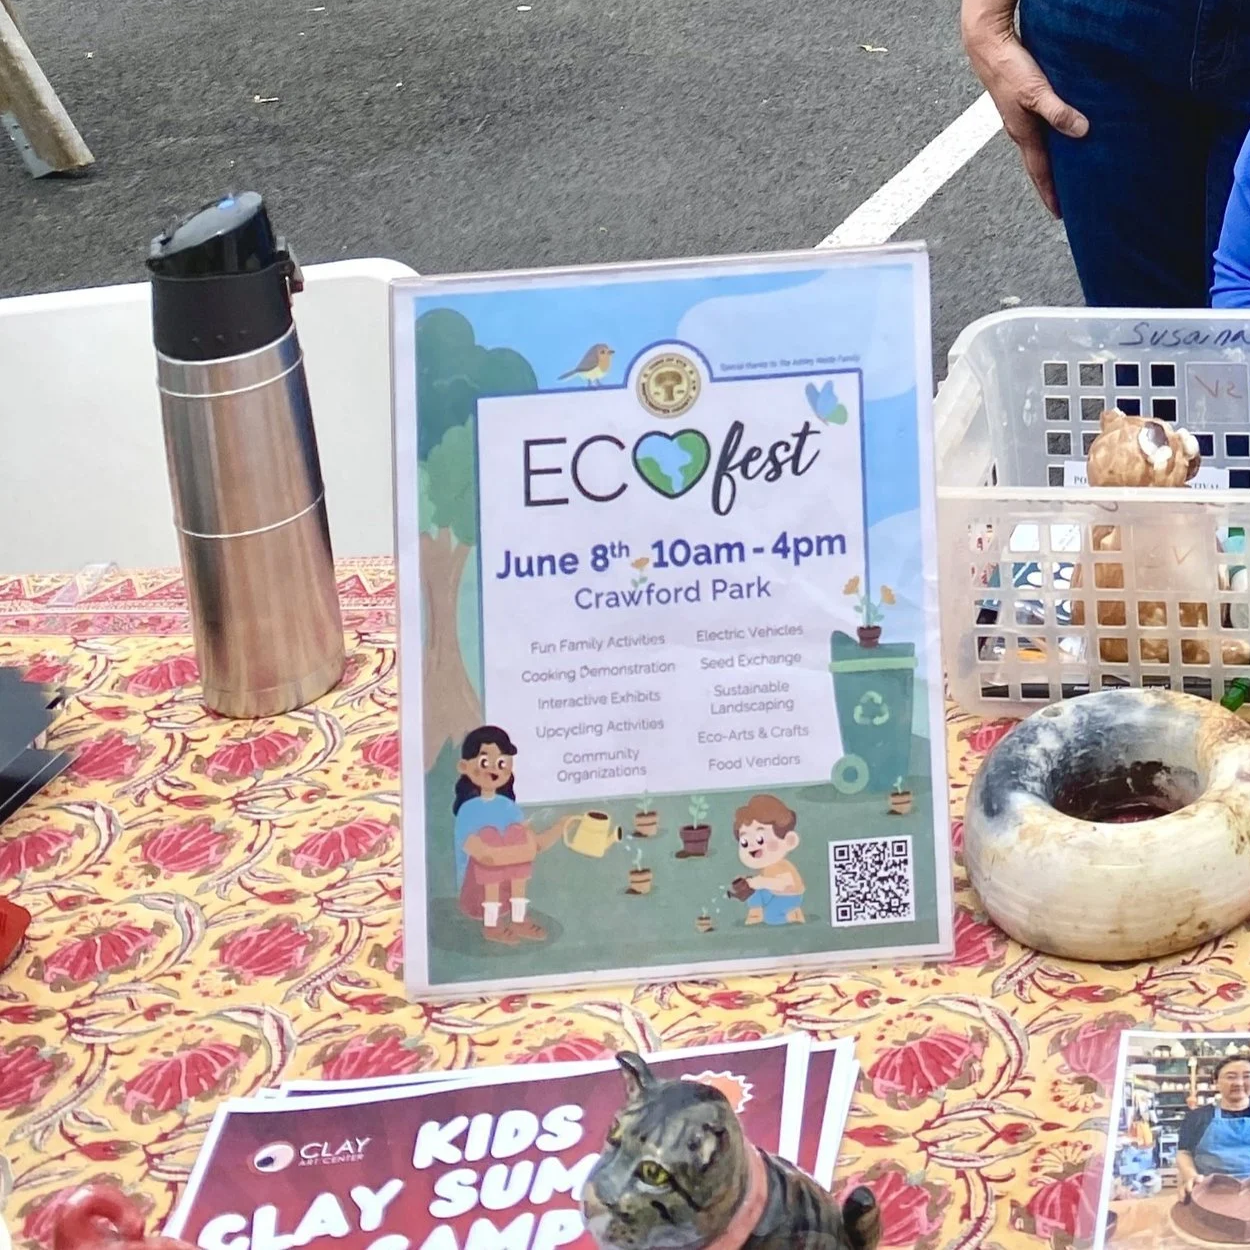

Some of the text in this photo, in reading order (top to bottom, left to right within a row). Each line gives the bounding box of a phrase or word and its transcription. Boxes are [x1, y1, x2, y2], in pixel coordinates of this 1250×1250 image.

[495, 549, 580, 580] June
[590, 540, 631, 573] 8th
[573, 576, 772, 612] Crawford Park
[529, 632, 666, 656] Fun Family Activities
[695, 622, 804, 643] Electric Vehicles
[520, 659, 676, 685] Cooking Demonstration
[699, 651, 802, 670] Seed Exchange
[537, 688, 661, 710] Interactive Exhibits
[713, 679, 790, 697] Sustainable
[709, 697, 795, 717] Landscaping
[535, 717, 665, 741] Upcycling Activities
[697, 722, 810, 745] Eco-Arts & Crafts
[562, 746, 640, 767] Community
[708, 751, 801, 772] Food Vendors
[556, 763, 647, 784] Organizations
[299, 1136, 371, 1160] CLAY
[411, 1103, 585, 1170] KIDS
[196, 1177, 405, 1250] CLAY
